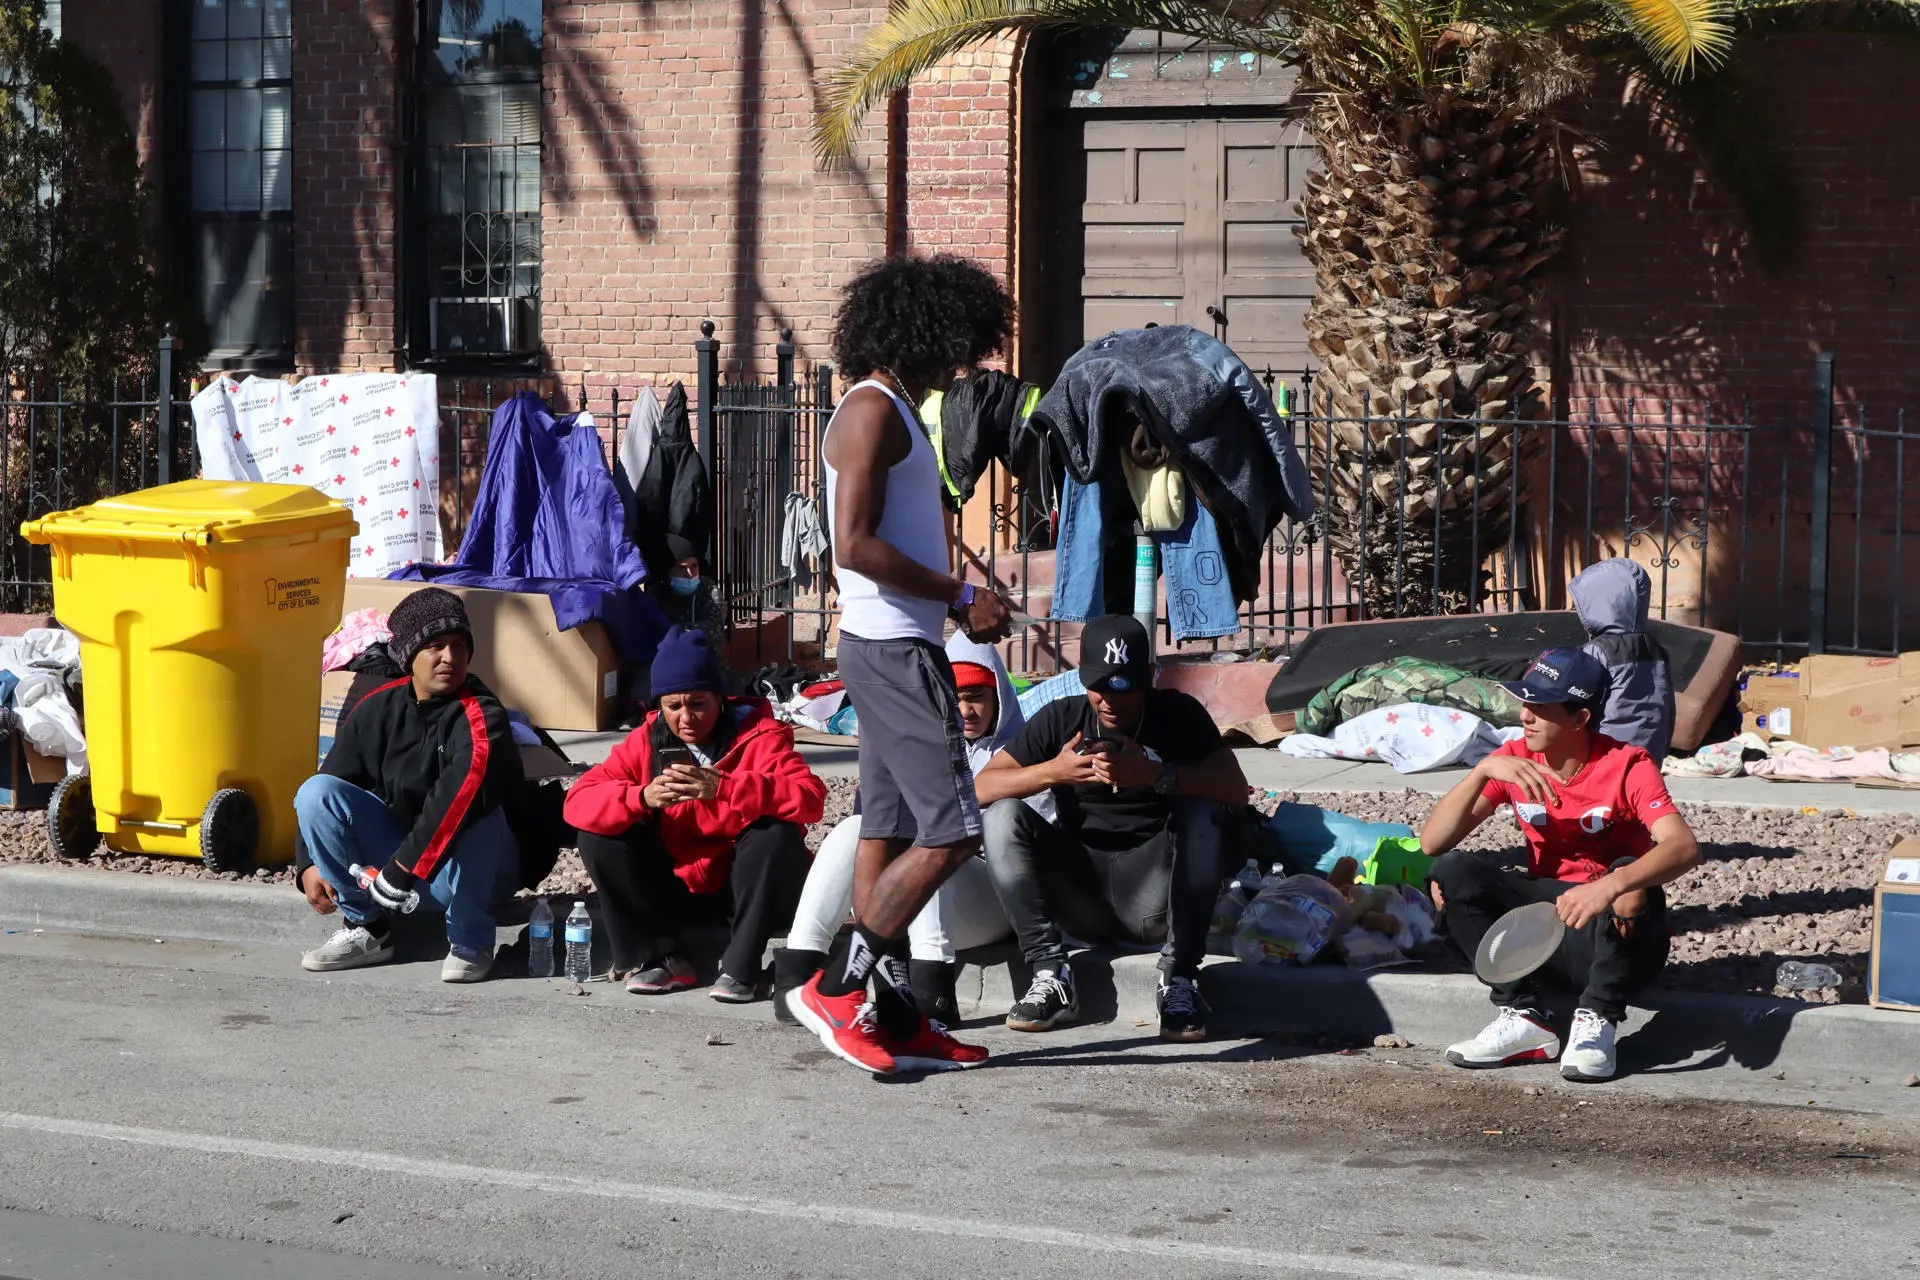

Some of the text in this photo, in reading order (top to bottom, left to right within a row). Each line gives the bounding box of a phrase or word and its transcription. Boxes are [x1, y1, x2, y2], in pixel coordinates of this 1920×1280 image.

[277, 577, 320, 591] ENVIRONMENTAL
[286, 589, 312, 599] SERVICES
[278, 603, 290, 611] CITY
[298, 600, 305, 608] EL
[306, 597, 320, 606] PASO
[1567, 686, 1594, 700] telcel
